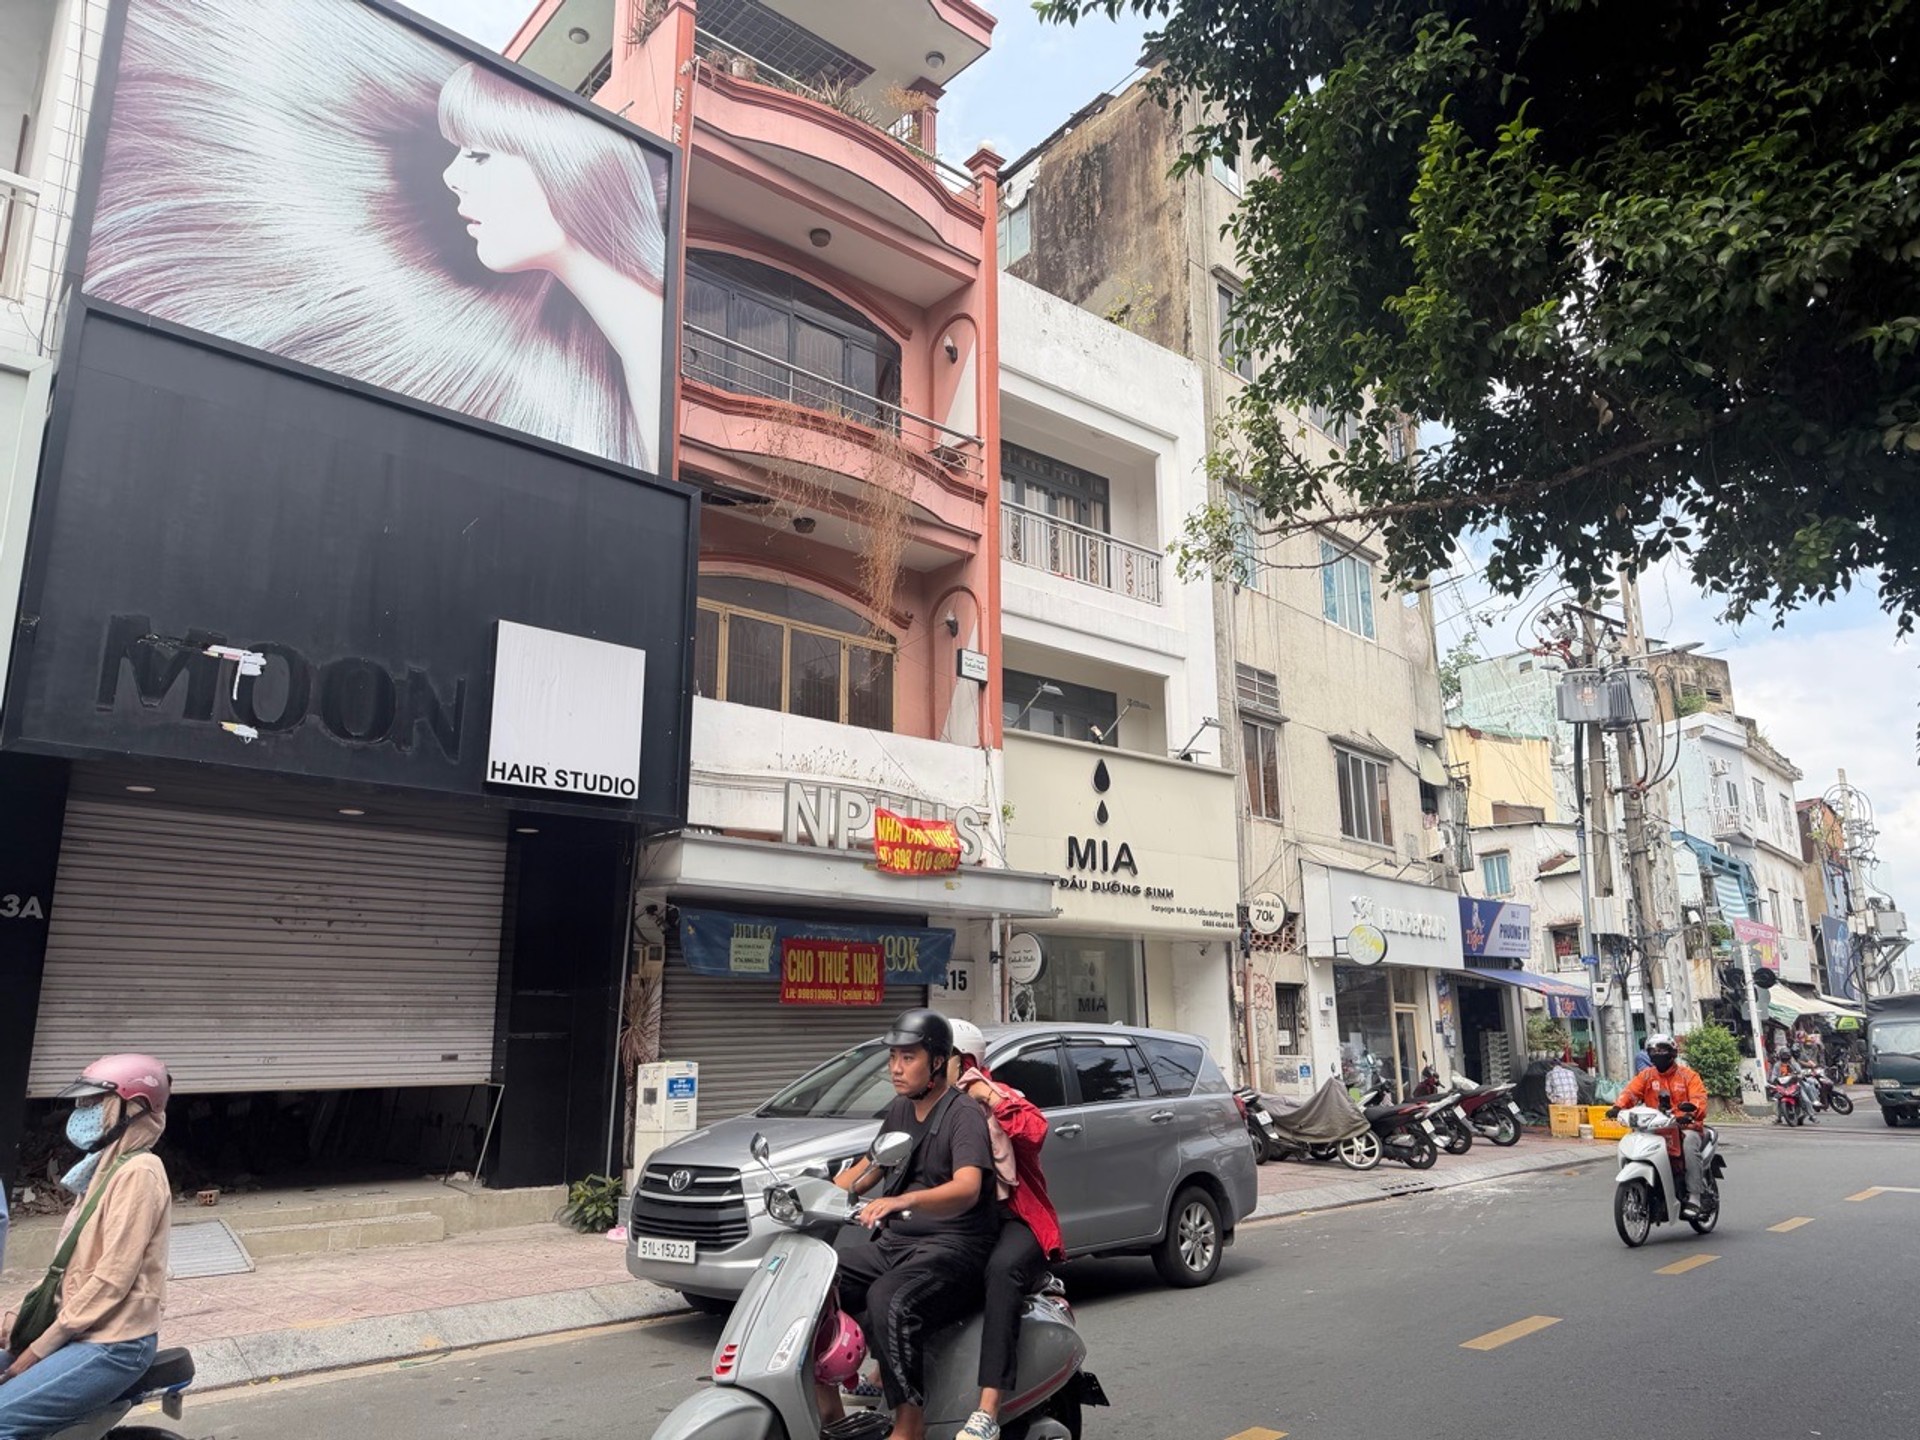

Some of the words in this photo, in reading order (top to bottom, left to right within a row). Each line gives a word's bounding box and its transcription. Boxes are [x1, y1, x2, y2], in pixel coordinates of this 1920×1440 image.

[97, 614, 467, 764] MOON
[490, 760, 547, 786] HAIR
[554, 769, 636, 796] STUDIO
[782, 781, 982, 866] NPS
[1067, 835, 1138, 877] MIA
[0, 893, 44, 919] 3A
[1145, 886, 1174, 900] SINH
[1255, 909, 1275, 922] 70k
[787, 949, 814, 983] CHO
[854, 947, 879, 986] NHÀ
[1078, 997, 1107, 1012] MIA
[641, 1240, 690, 1259] 51L-152.23
